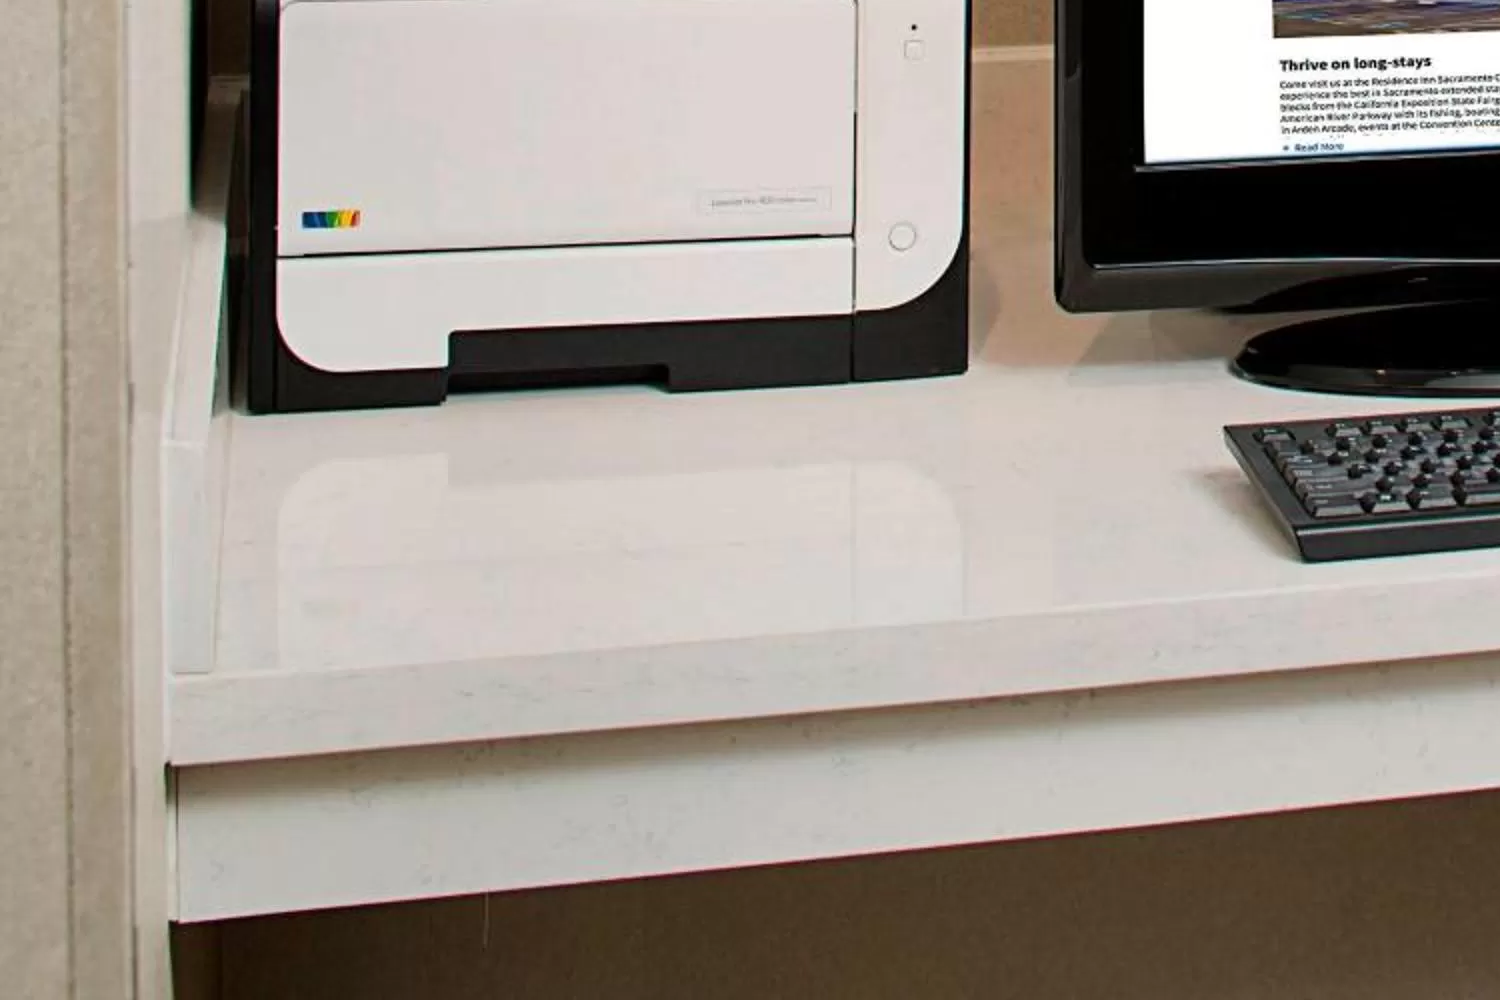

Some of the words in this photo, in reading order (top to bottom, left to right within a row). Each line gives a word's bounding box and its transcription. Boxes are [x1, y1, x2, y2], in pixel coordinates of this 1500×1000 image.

[1280, 58, 1328, 72] Thrive
[1331, 60, 1351, 70] on
[1354, 56, 1432, 71] long-stays
